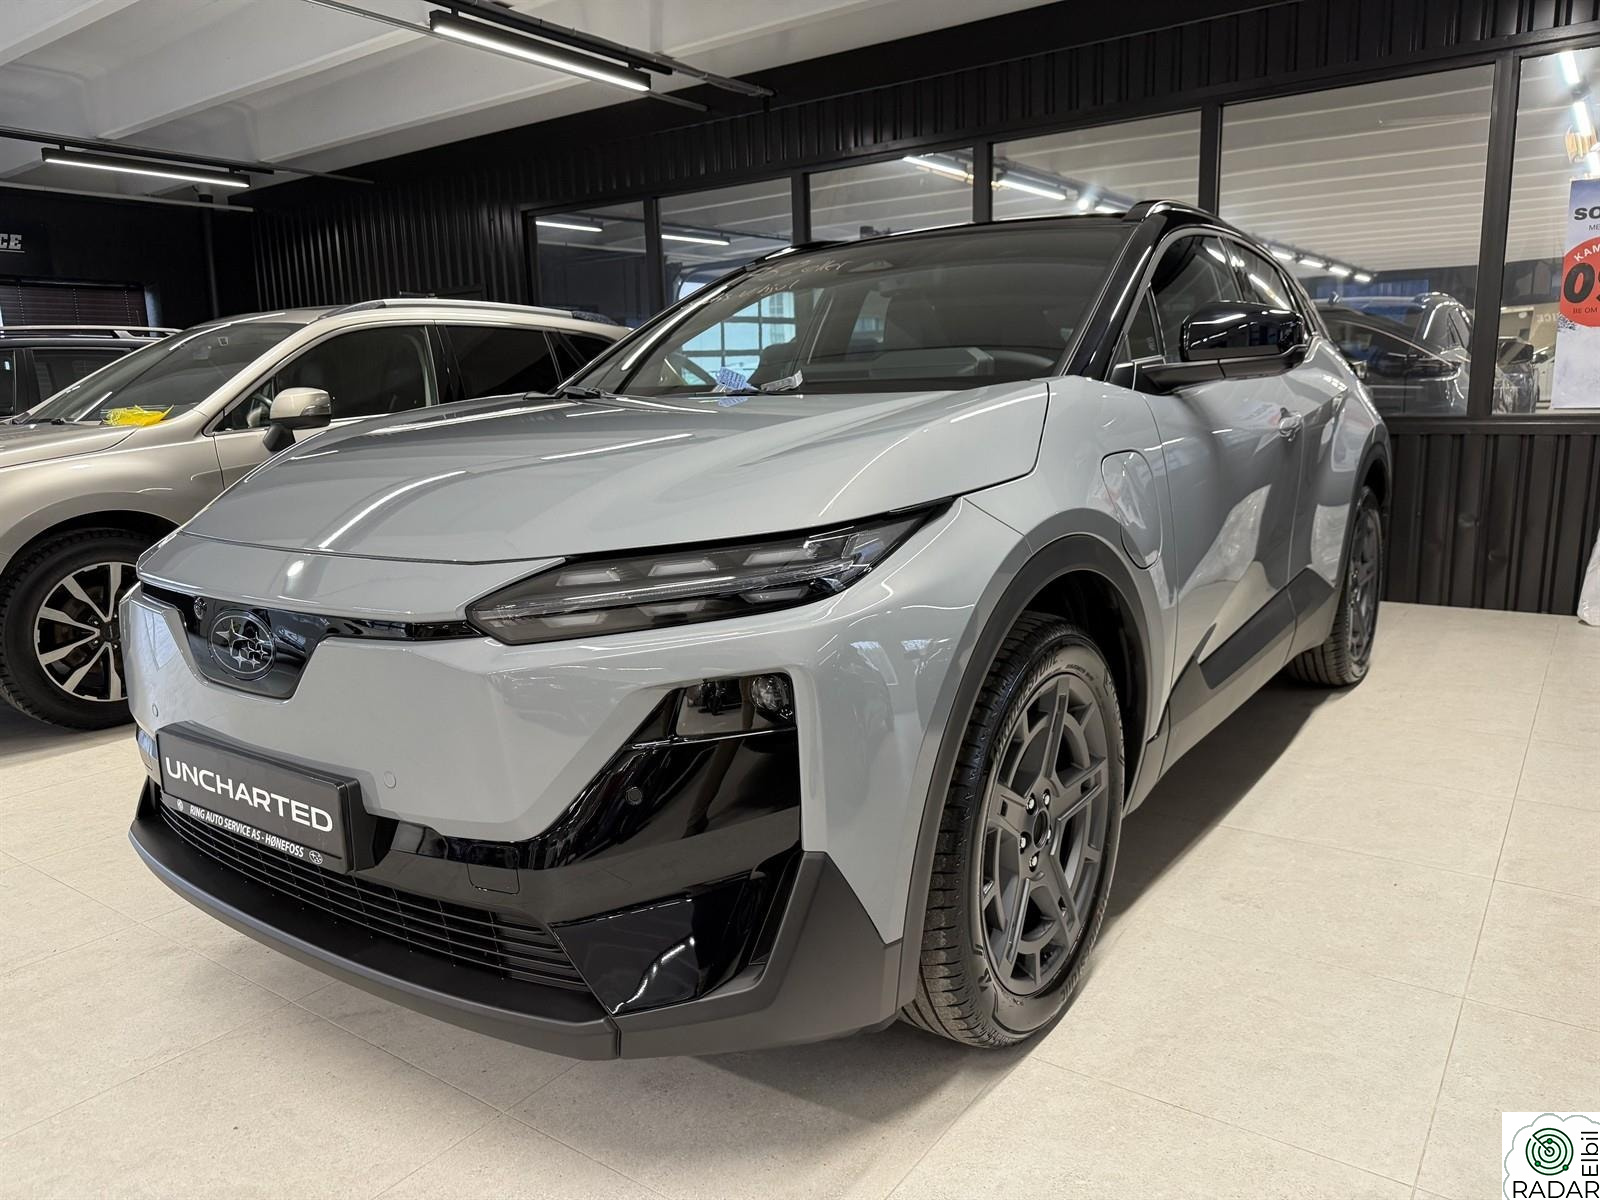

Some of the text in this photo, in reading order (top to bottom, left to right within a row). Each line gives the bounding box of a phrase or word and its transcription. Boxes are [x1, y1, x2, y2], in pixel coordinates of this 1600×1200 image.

[165, 756, 333, 832] UNCHARTED
[190, 804, 205, 820] RING
[205, 811, 224, 826] AUTO
[224, 816, 251, 837] SERVICE
[251, 830, 261, 841] AS
[265, 833, 305, 858] HØNEFOSS
